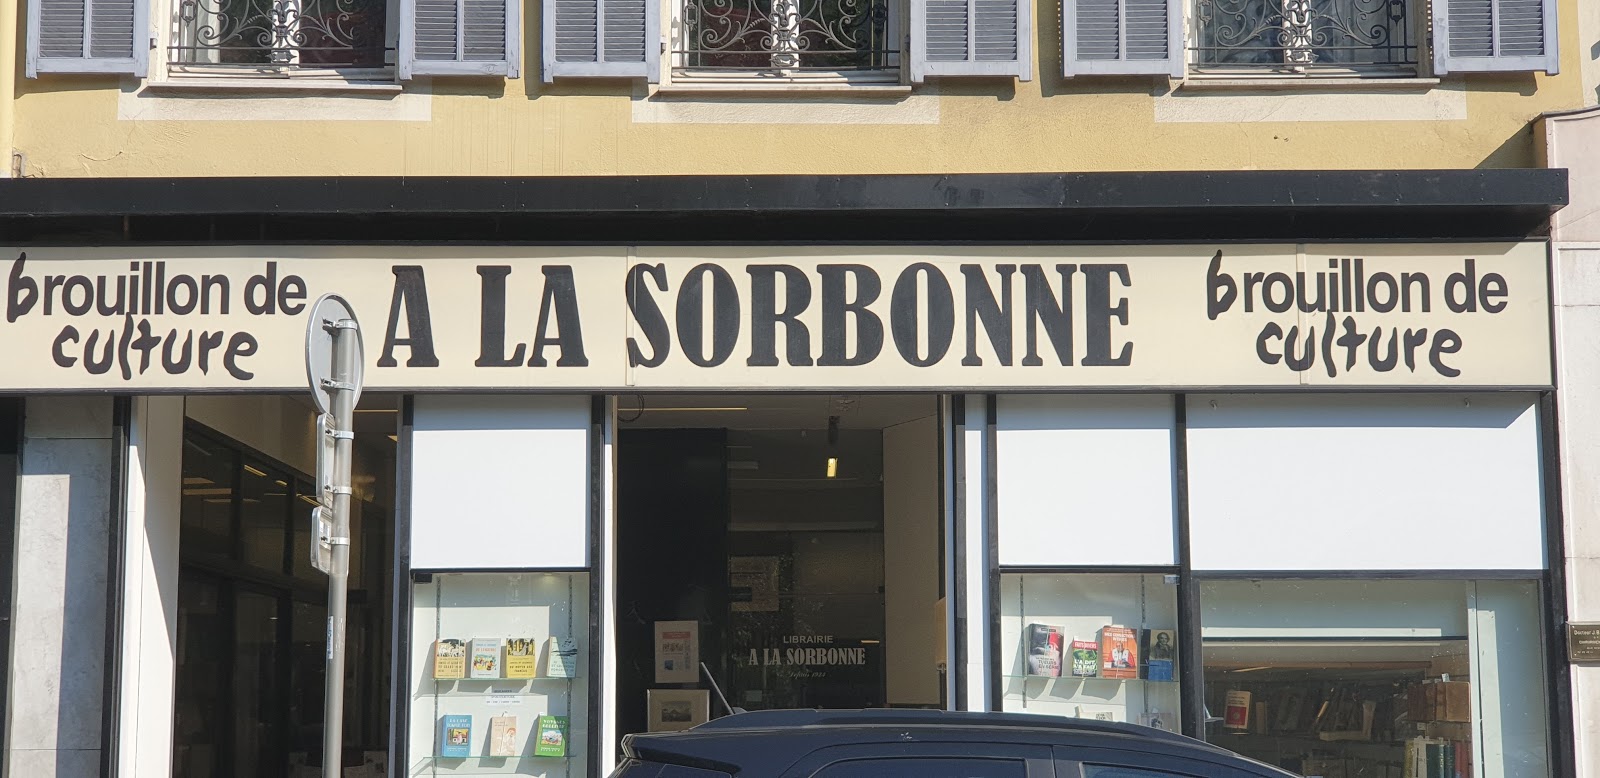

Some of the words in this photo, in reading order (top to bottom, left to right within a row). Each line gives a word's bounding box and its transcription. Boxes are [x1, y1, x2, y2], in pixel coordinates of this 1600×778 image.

[7, 252, 230, 323] brouillon
[244, 261, 307, 316] de
[377, 265, 440, 368] A
[475, 264, 589, 368] LA
[625, 262, 1134, 368] SORBONNE
[1207, 249, 1431, 320] brouillon
[1445, 258, 1509, 314] de
[52, 313, 258, 381] culture
[1256, 310, 1463, 378] culture
[748, 648, 758, 666] A
[763, 648, 782, 666] LA
[786, 647, 866, 666] SORBONNE
[783, 635, 833, 644] LIBRAIRIE
